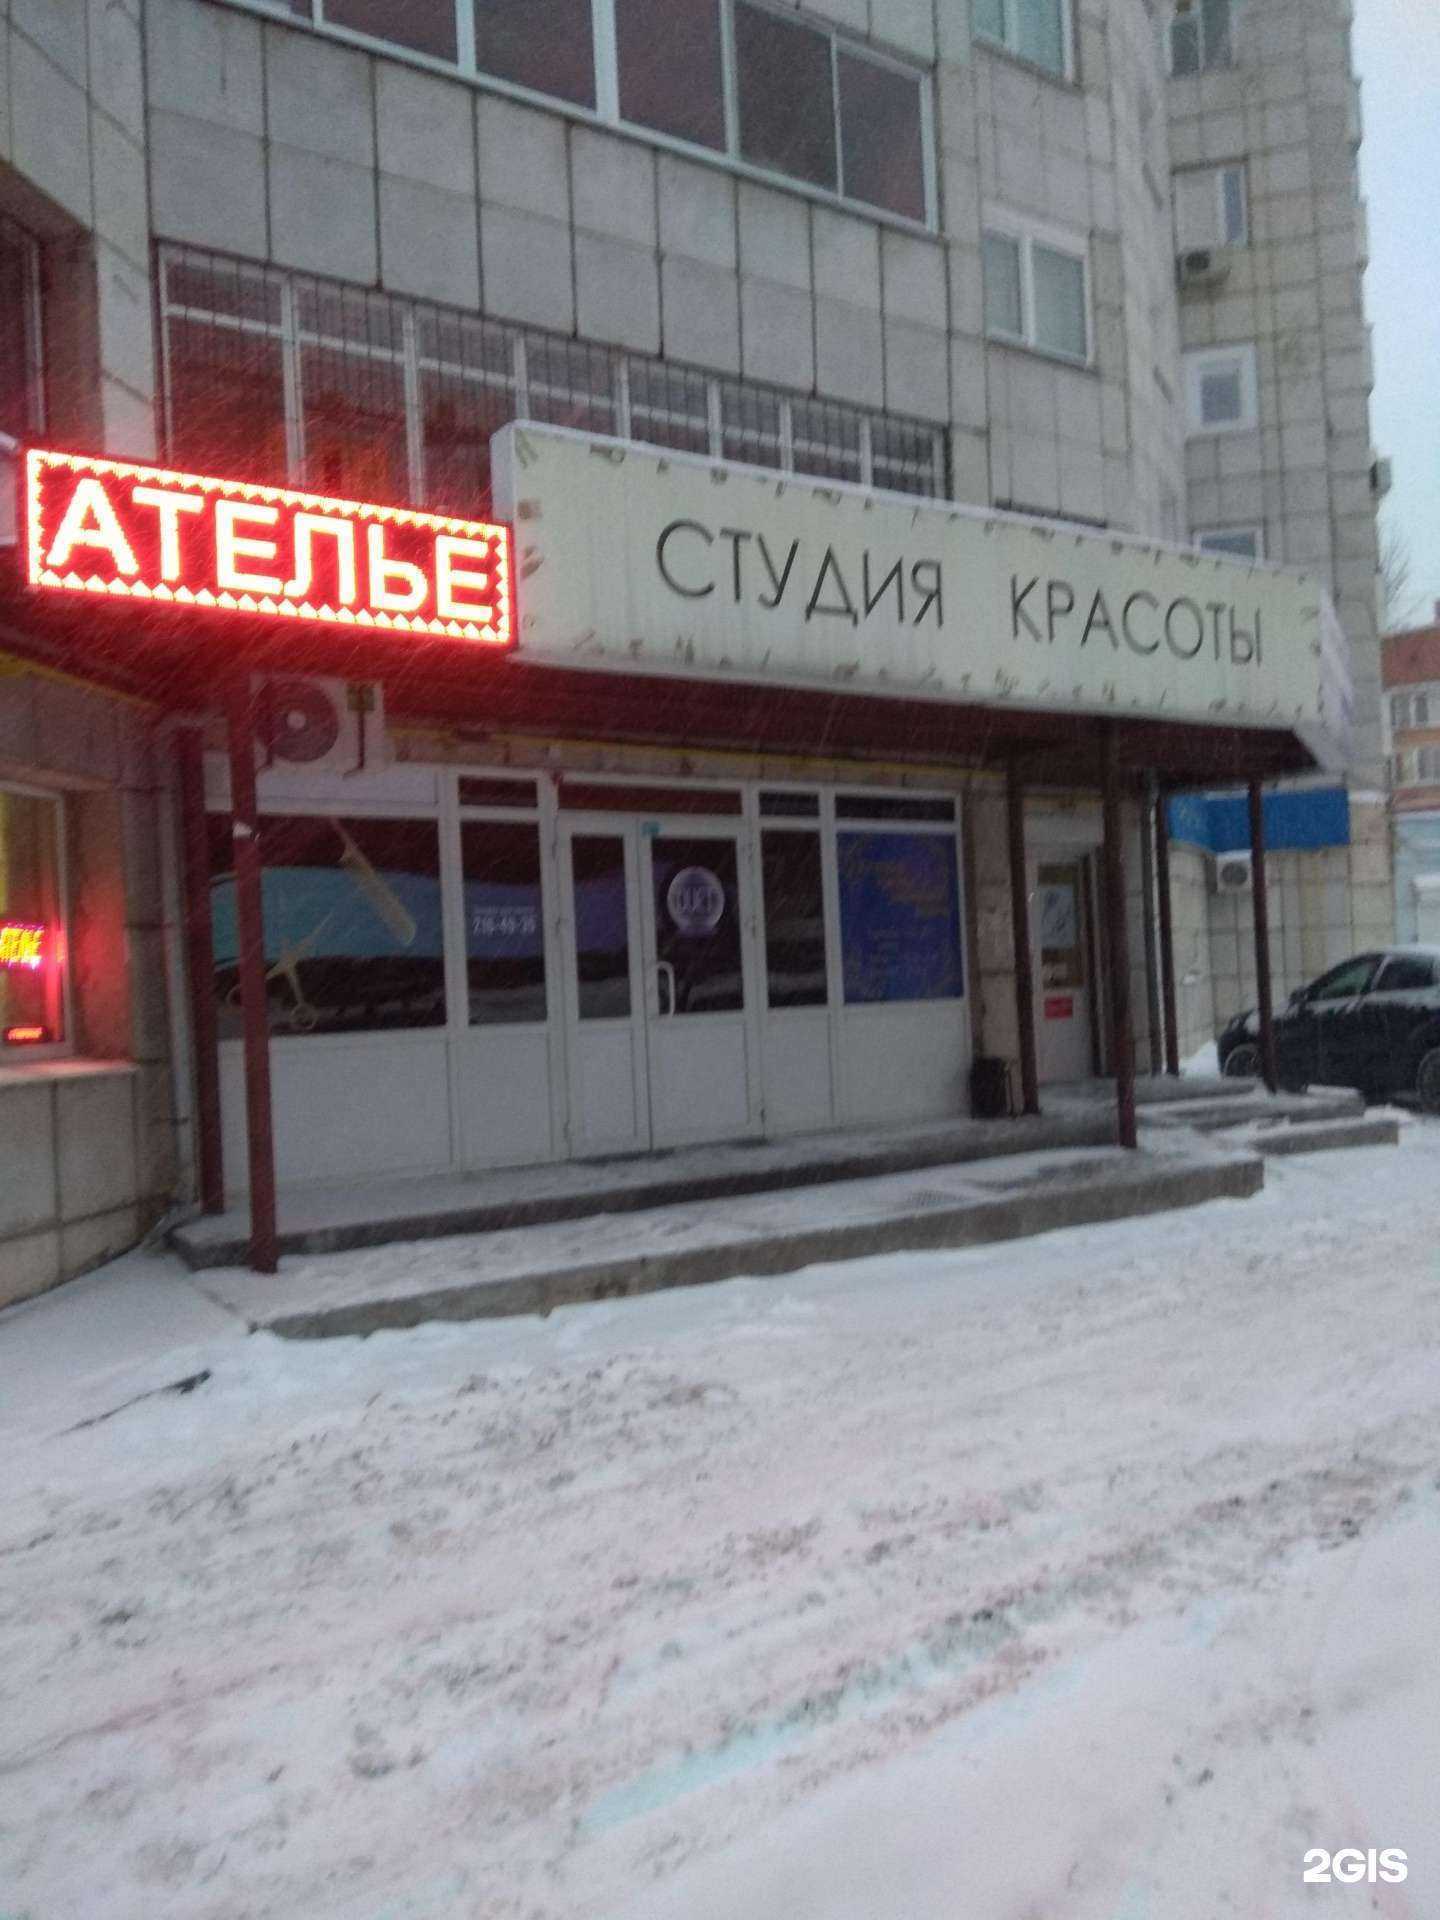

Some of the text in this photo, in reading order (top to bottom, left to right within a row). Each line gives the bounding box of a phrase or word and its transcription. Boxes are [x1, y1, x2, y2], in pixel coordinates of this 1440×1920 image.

[46, 478, 494, 623] АТЕЛЬЕ
[656, 518, 1263, 670] СТУДИЯ КРАСОТЫ
